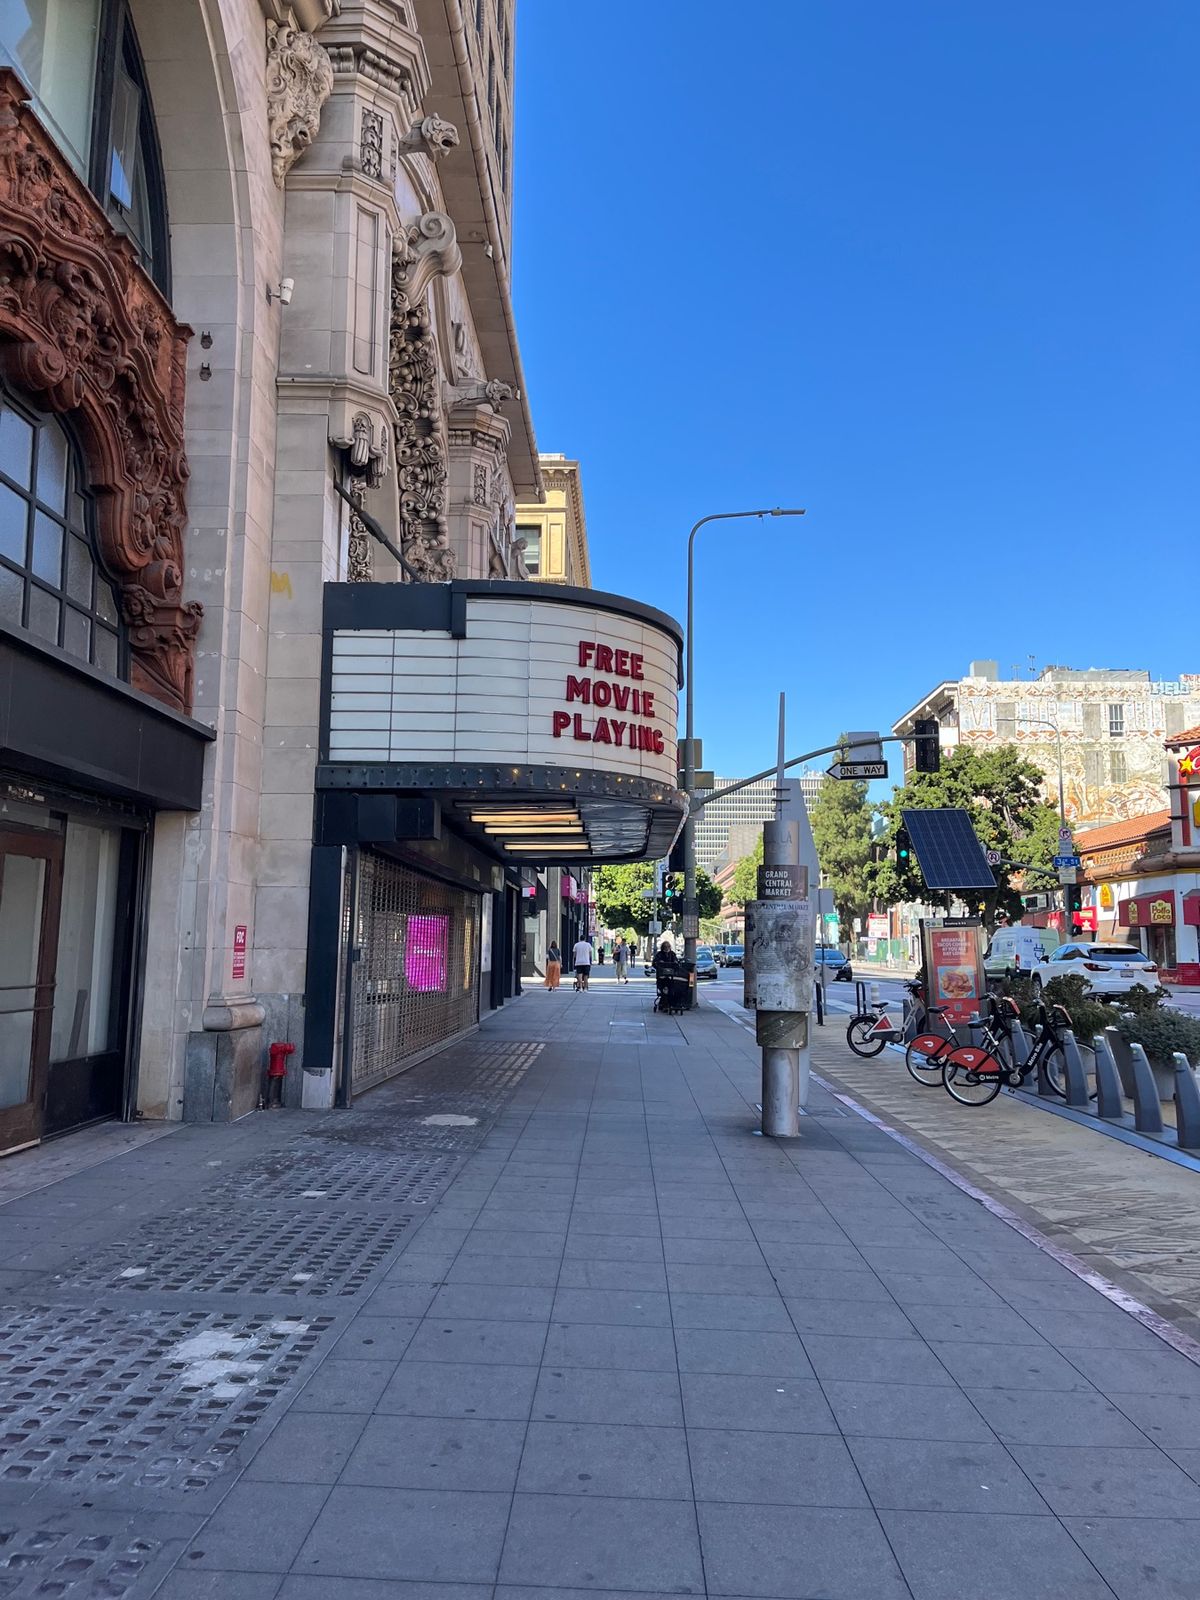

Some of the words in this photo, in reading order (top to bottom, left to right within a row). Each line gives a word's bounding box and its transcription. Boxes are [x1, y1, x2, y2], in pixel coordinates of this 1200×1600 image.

[578, 640, 645, 681] FREE
[566, 675, 656, 718] MOVIE
[552, 710, 665, 755] PLAYING
[840, 766, 858, 776] ONE
[863, 765, 882, 775] WAY
[765, 870, 789, 879] GRAND
[765, 879, 793, 888] CENTRAL
[765, 888, 792, 897] MARKET
[1153, 913, 1171, 921] Loco
